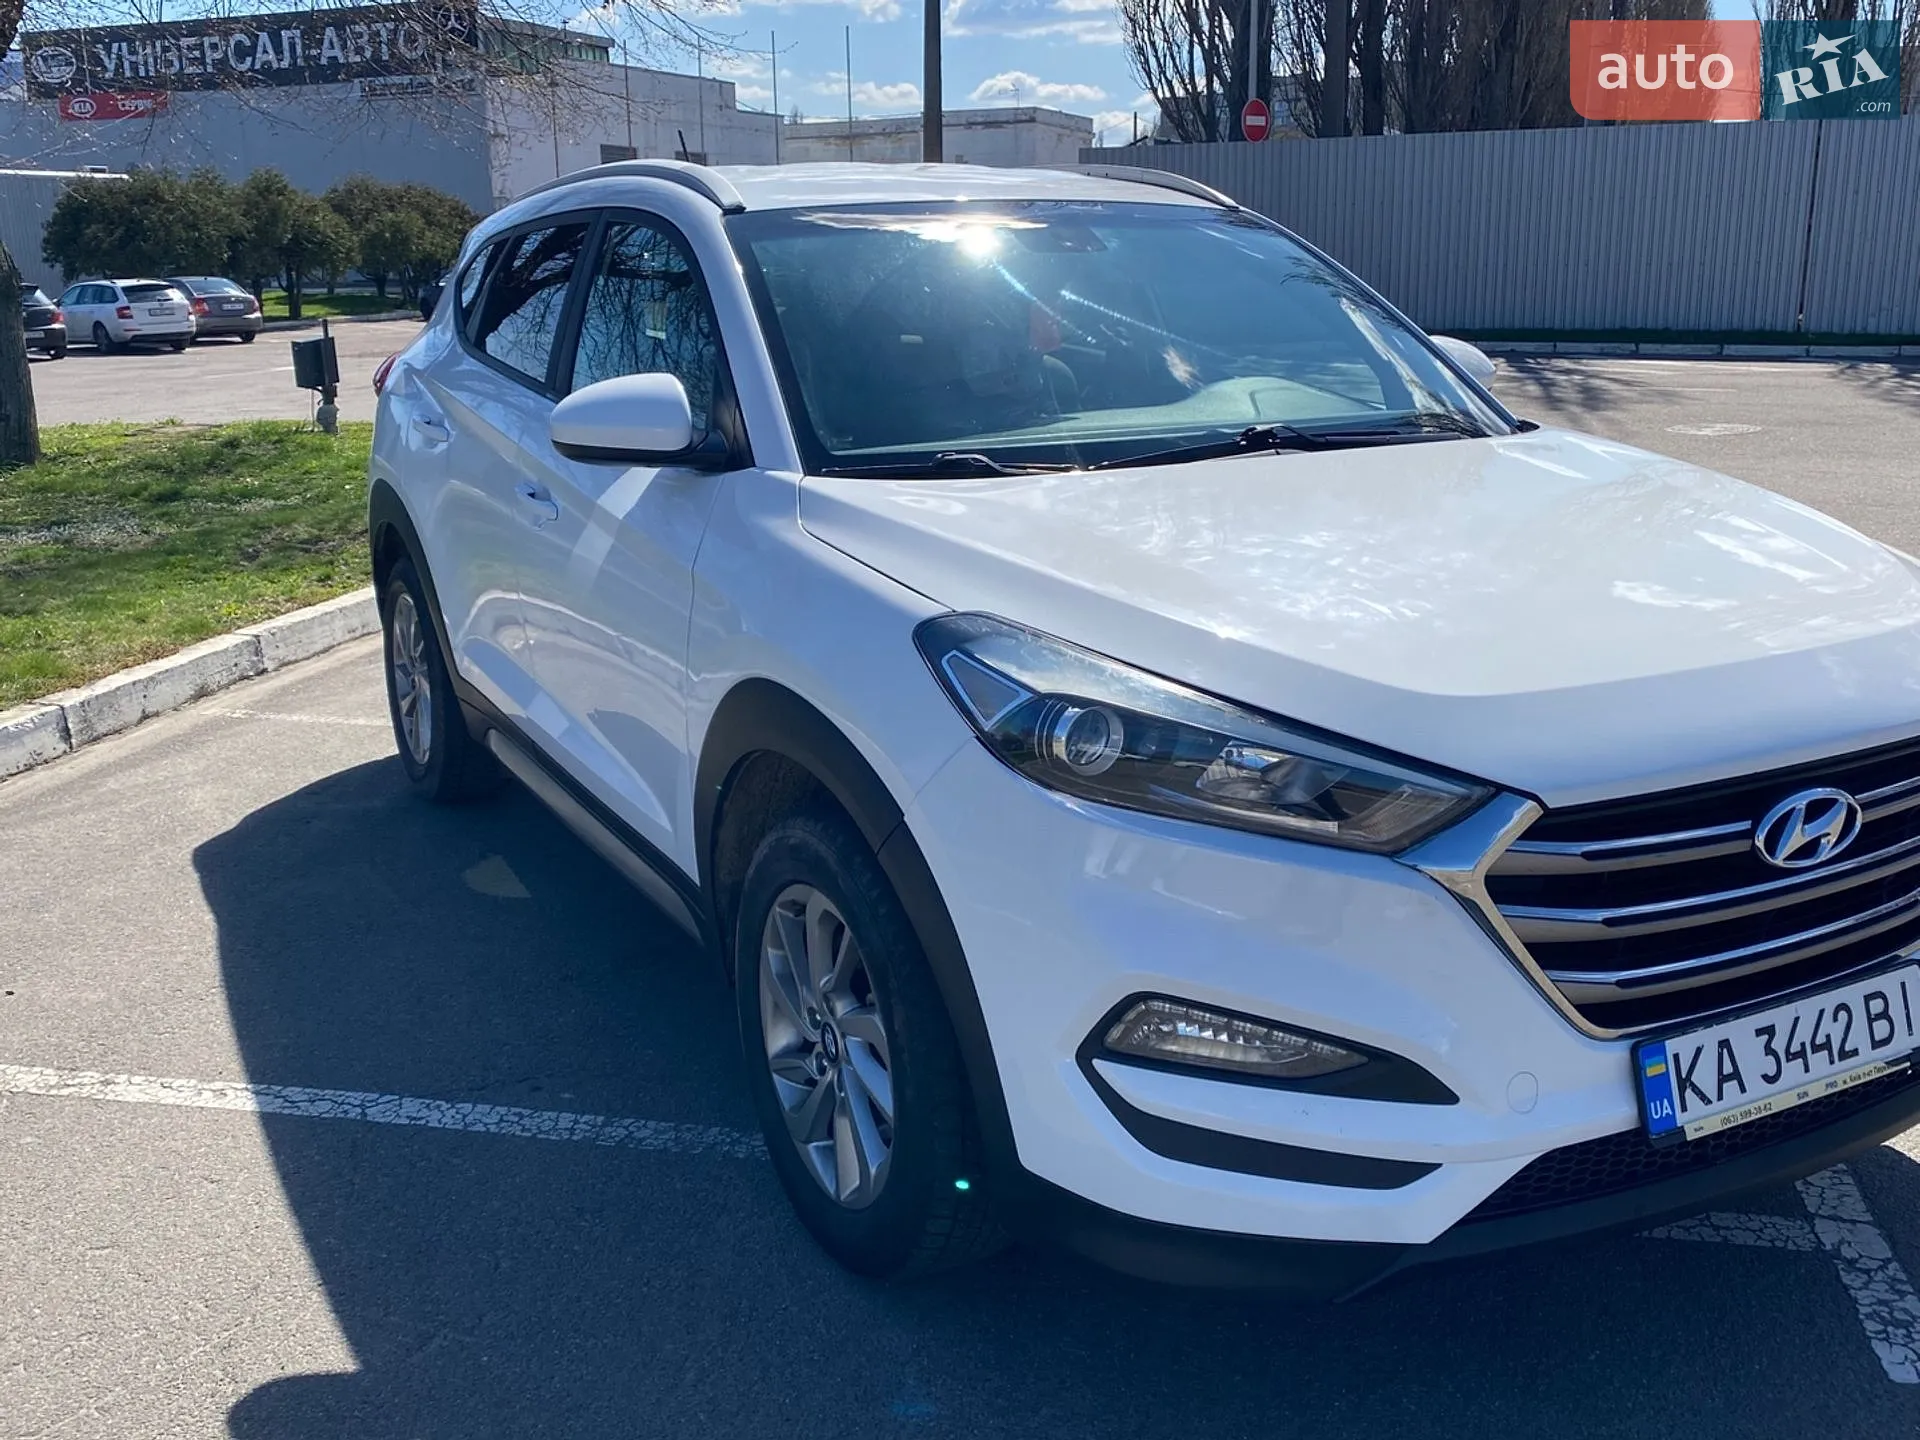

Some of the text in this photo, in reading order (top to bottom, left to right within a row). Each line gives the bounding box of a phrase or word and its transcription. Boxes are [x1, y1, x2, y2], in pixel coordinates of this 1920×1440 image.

[73, 102, 92, 112] KIA
[1672, 1038, 1747, 1113] KA
[1755, 1002, 1859, 1086] 3442
[1649, 1098, 1673, 1120] UA
[1720, 1113, 1739, 1128] (063)
